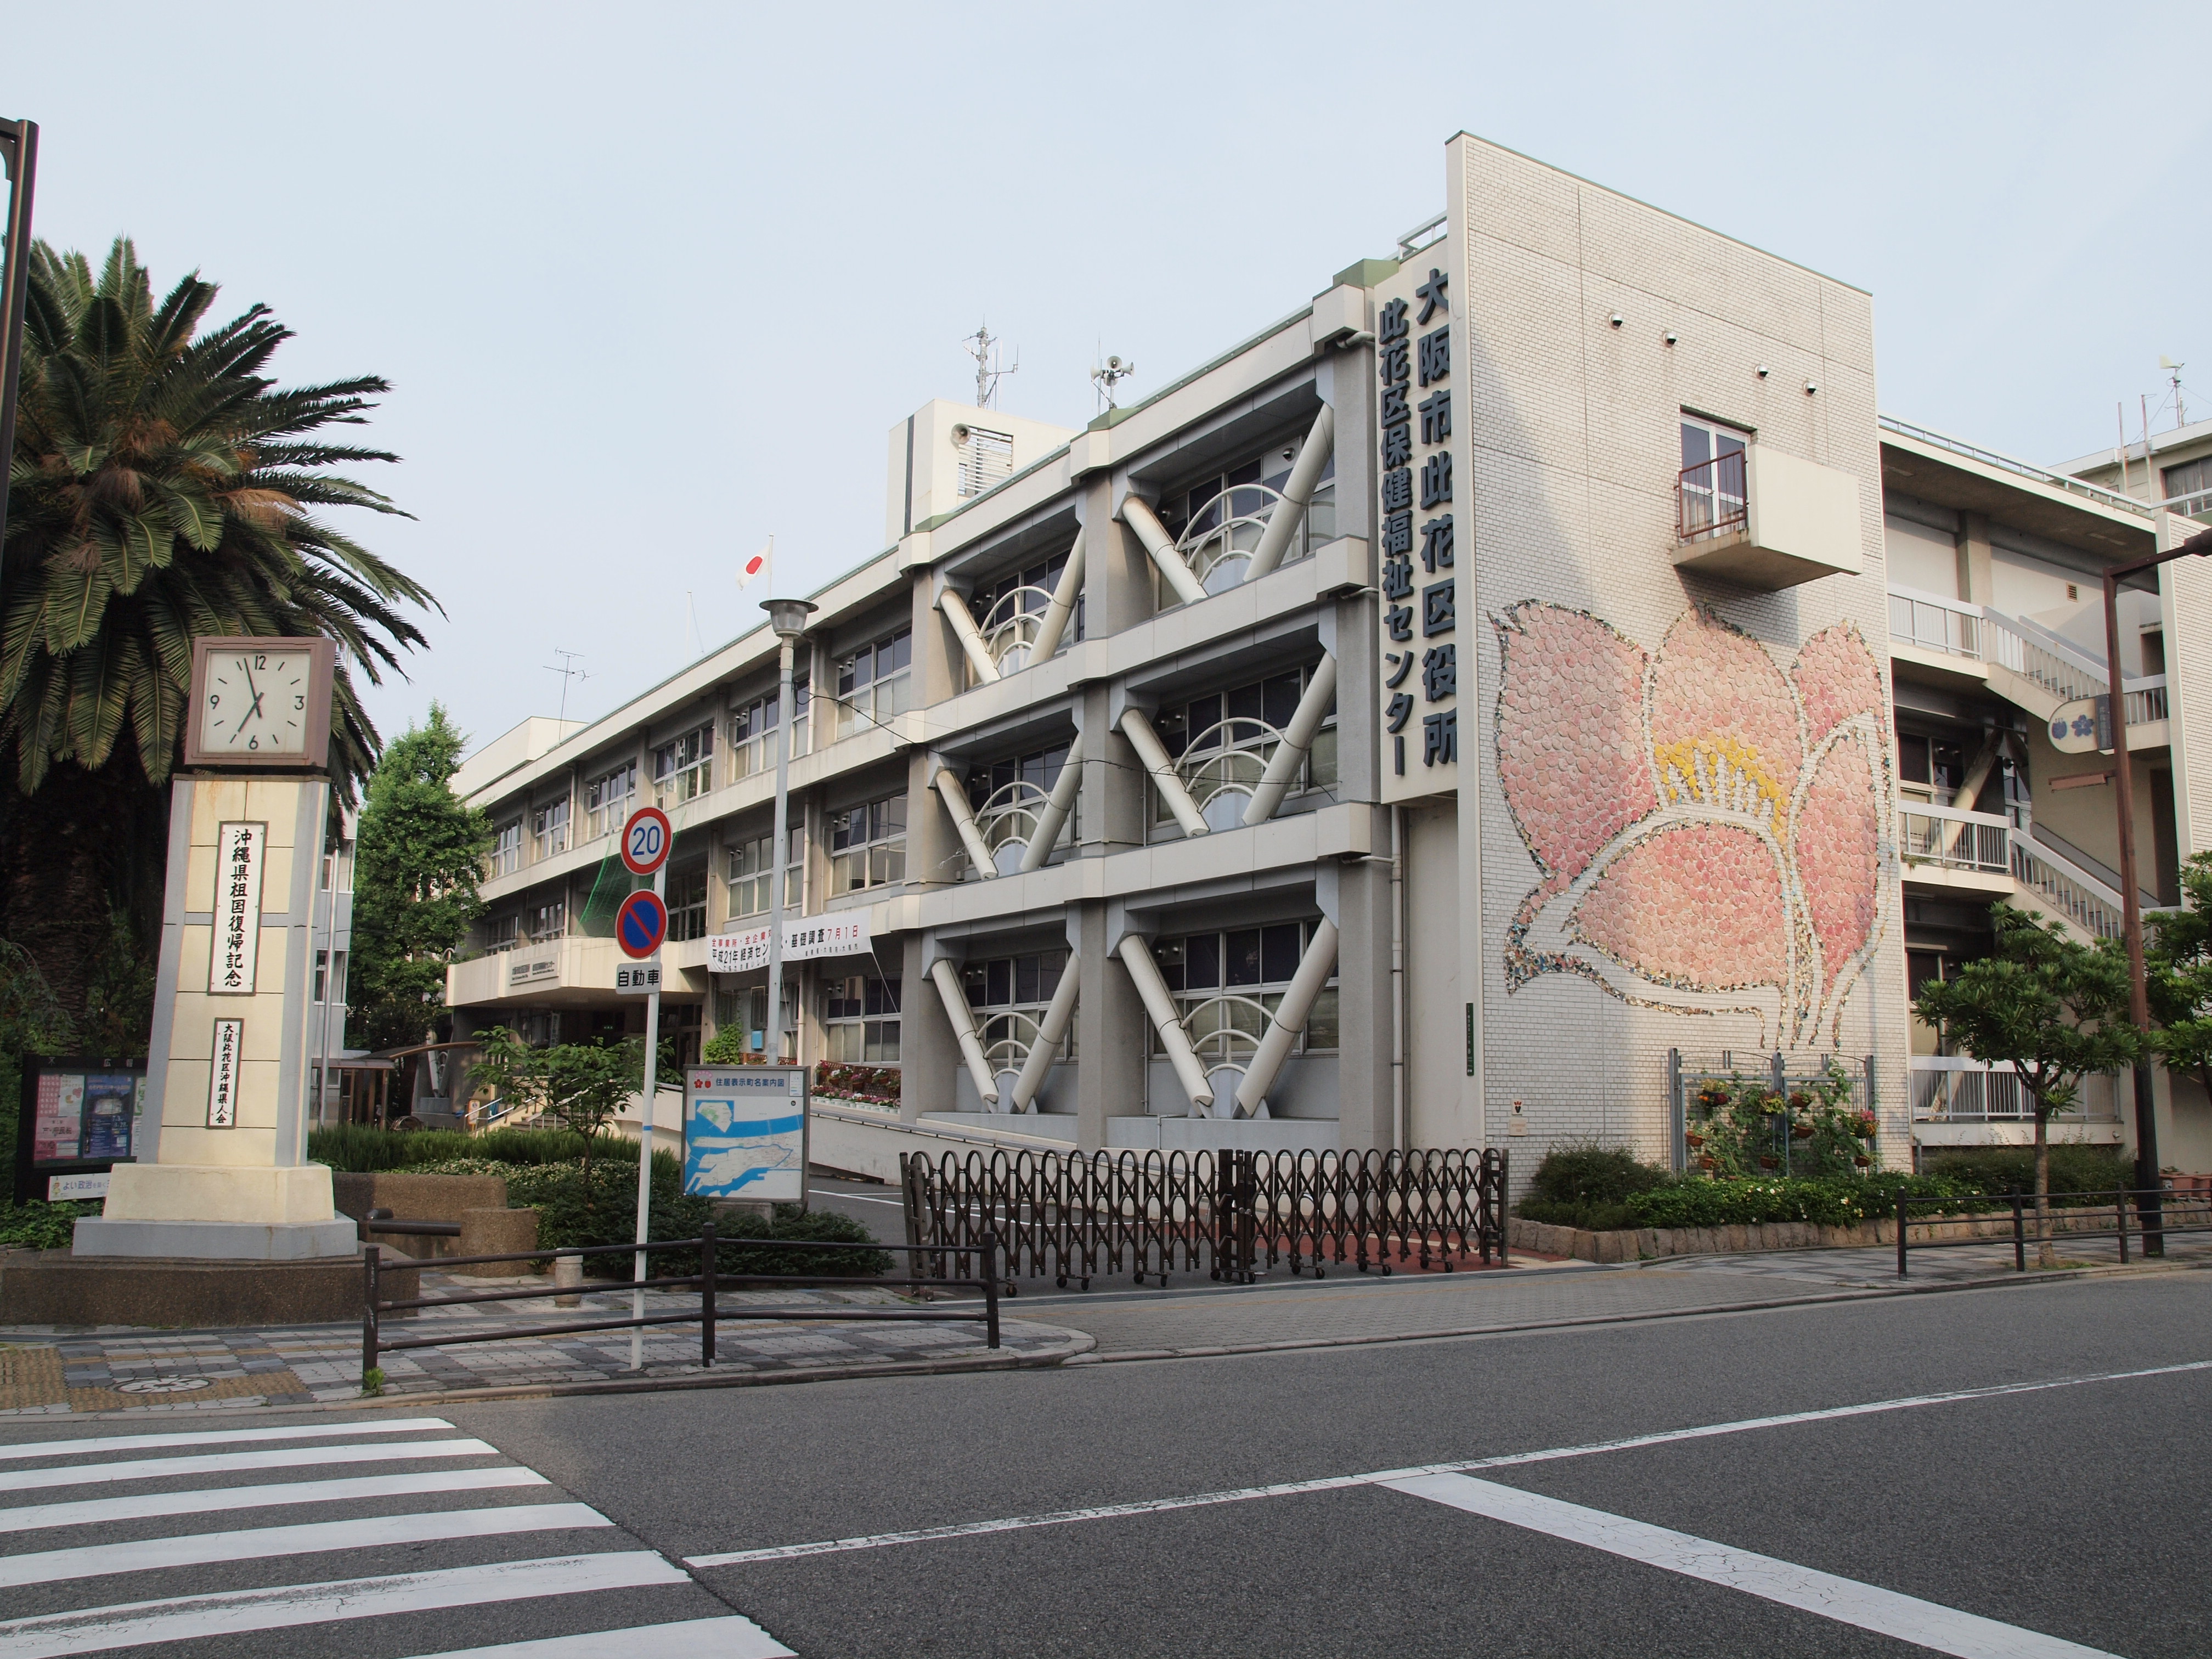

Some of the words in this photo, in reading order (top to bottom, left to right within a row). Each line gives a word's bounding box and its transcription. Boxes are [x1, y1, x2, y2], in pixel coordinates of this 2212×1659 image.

[1416, 268, 1457, 767] 大阪市此花区役所
[1379, 297, 1414, 776] 此花区保健福祉センター
[255, 655, 266, 670] 12
[210, 695, 219, 709] 9
[295, 696, 304, 710] 3
[249, 735, 258, 749] 6
[632, 826, 660, 856] 20
[224, 828, 252, 988] 沖縄県祖国復帰記念
[618, 969, 659, 986] 自動車
[216, 1024, 234, 1124] 大阪此花区沖縄県人会
[716, 1077, 785, 1087] 住居表示町名案内図
